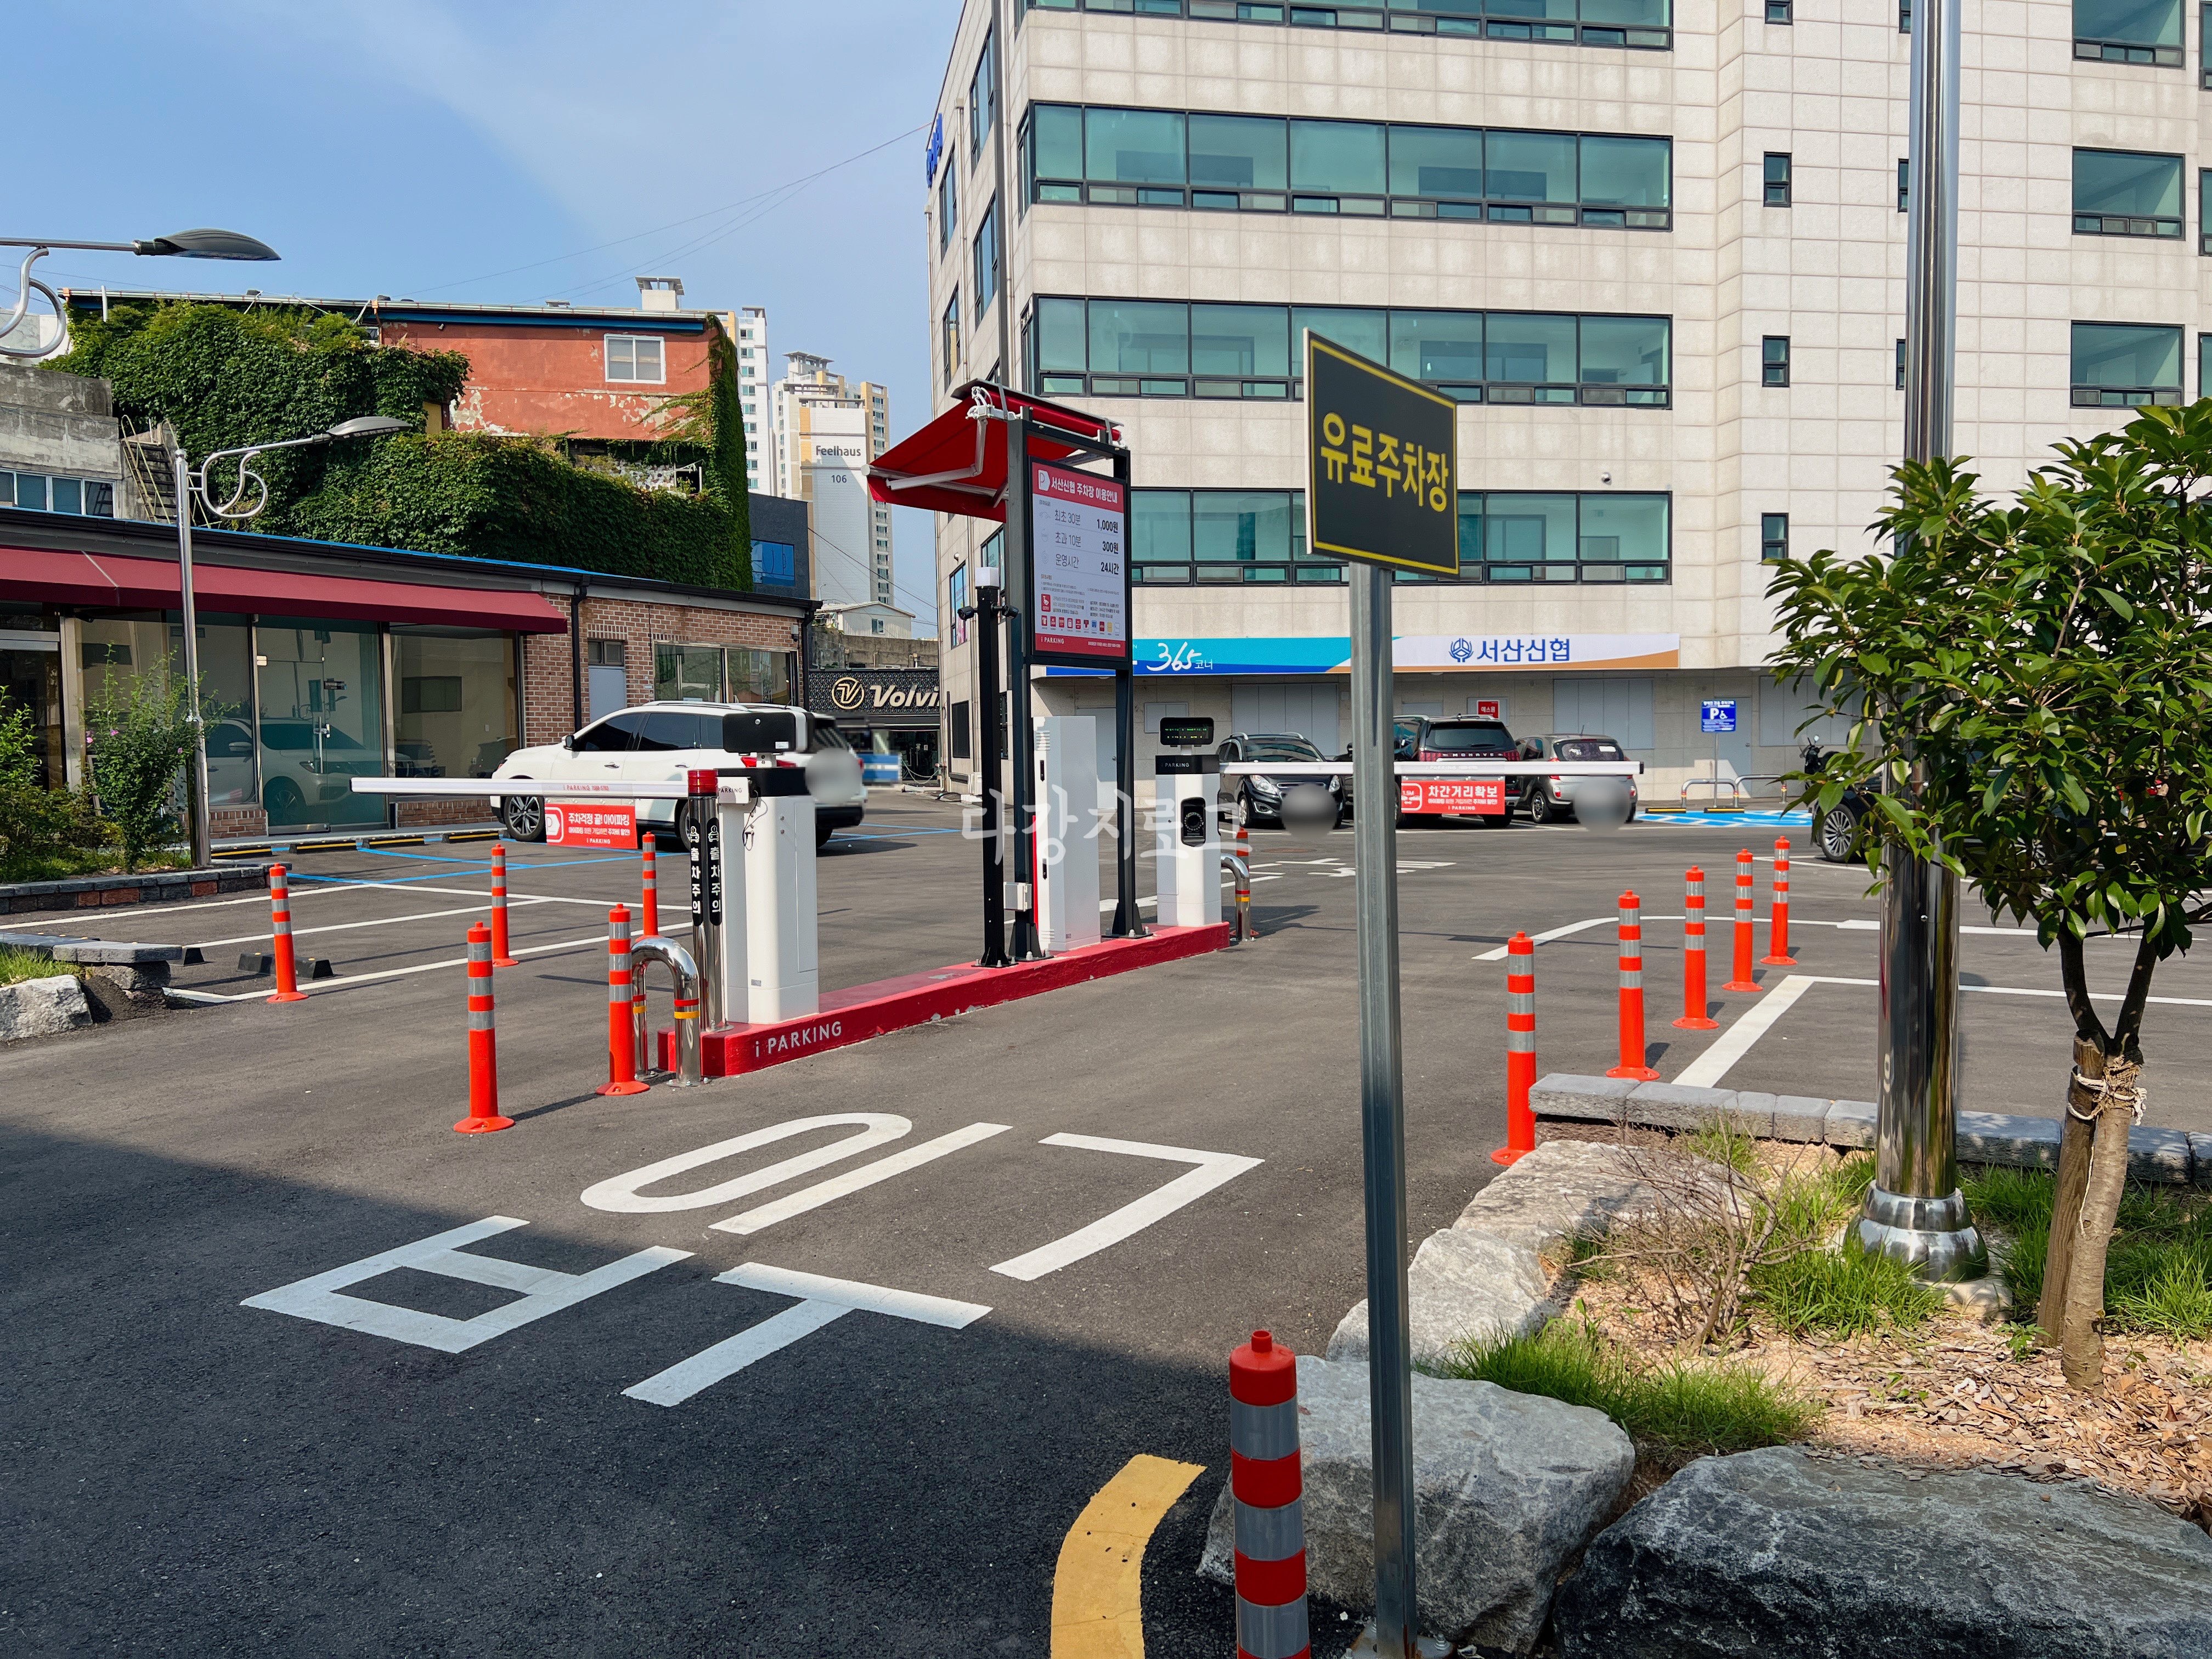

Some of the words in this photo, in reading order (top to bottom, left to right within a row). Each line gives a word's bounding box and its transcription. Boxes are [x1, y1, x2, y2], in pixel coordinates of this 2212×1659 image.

[816, 445, 861, 456] Feelhaus
[1321, 412, 1449, 512] 유료주차장
[831, 475, 847, 483] 106
[1051, 476, 1075, 494] 서산신협
[1077, 482, 1094, 498] 주차장
[1096, 487, 1118, 504] 이용안내
[1054, 509, 1066, 523] 최초
[1068, 513, 1081, 526] 30분
[1097, 519, 1118, 533] 1,000원
[1055, 531, 1067, 545] 초과
[1069, 535, 1081, 548] 10분
[1102, 541, 1119, 555] 300원
[1056, 554, 1079, 569] 운영시간
[1101, 562, 1119, 575] 24시간
[1044, 636, 1064, 645] PARKING
[1146, 641, 1202, 671] 365
[1194, 659, 1213, 670] 코너
[1477, 639, 1570, 662] 서산신협
[870, 685, 940, 708] Volvi
[1428, 785, 1498, 798] 차간거리확보
[568, 812, 593, 825] 주차걱정
[603, 814, 630, 826] 아이파킹
[690, 847, 701, 915] 출차주의
[710, 847, 721, 913] 출차주의
[755, 1040, 759, 1058] i
[768, 1021, 842, 1054] PARKING
[239, 1112, 1263, 1408] 입구
